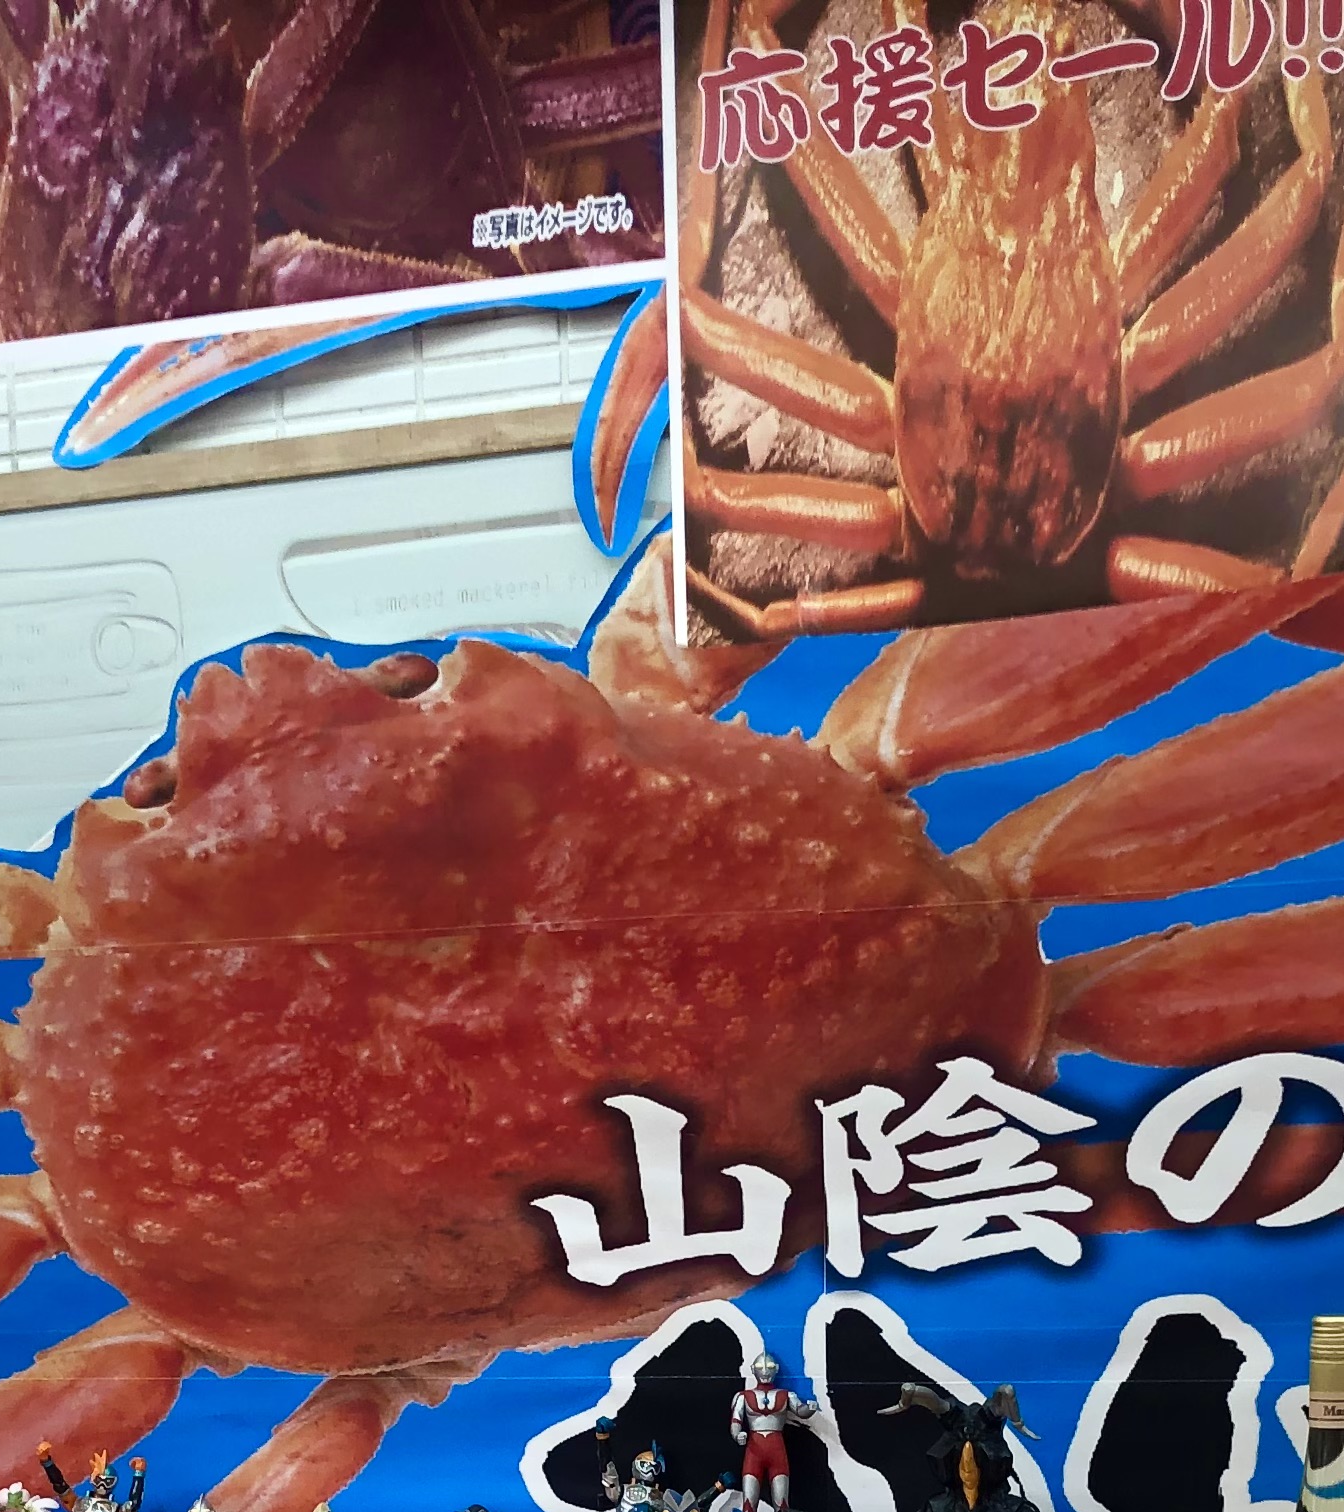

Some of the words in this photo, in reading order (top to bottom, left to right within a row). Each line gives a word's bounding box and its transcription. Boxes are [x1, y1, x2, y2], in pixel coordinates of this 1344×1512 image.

[472, 194, 634, 250] ※写真はイメージです。
